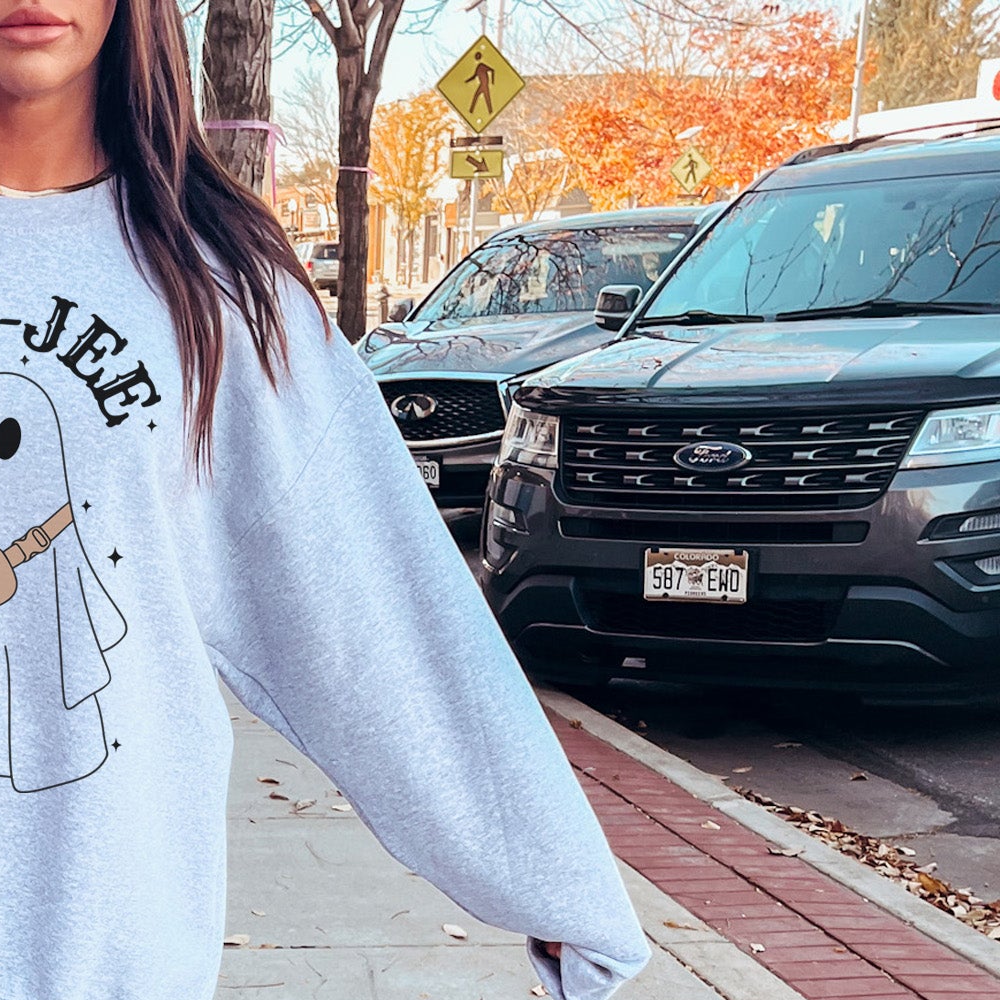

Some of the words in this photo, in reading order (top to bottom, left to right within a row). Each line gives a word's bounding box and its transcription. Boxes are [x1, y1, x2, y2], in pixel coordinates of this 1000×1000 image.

[688, 445, 732, 463] Ford
[674, 552, 719, 561] COLORADO
[653, 567, 684, 590] 587
